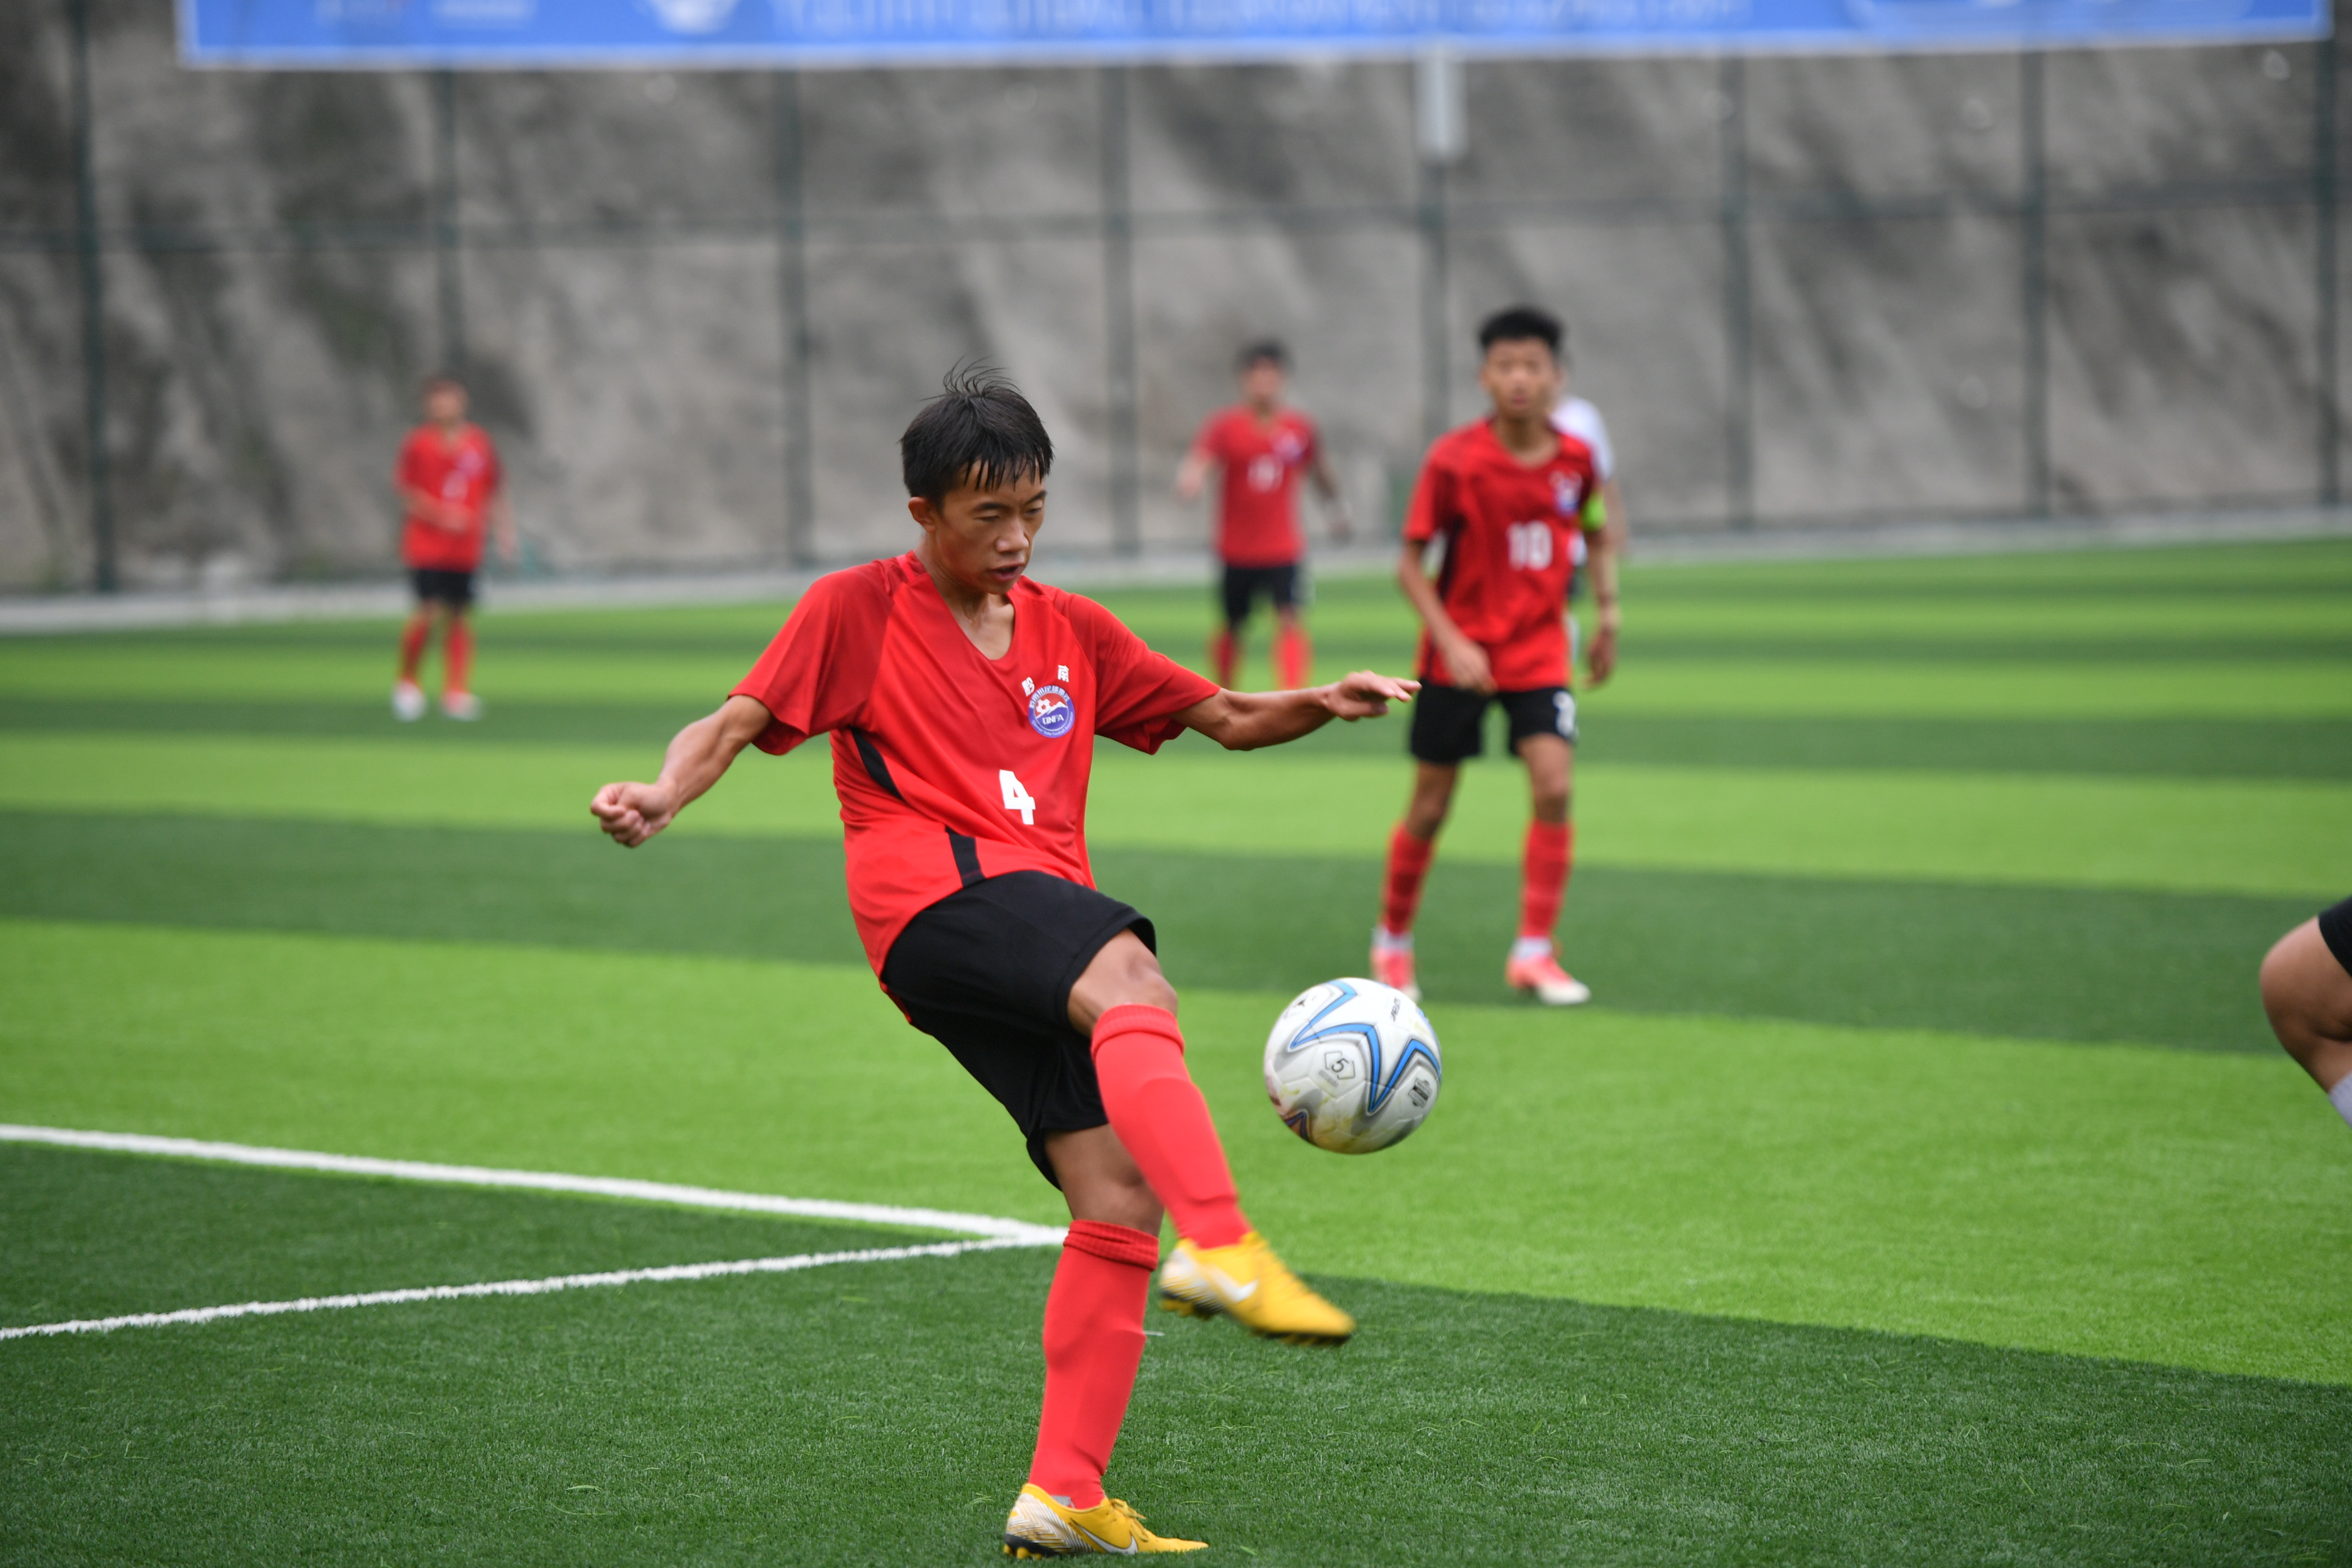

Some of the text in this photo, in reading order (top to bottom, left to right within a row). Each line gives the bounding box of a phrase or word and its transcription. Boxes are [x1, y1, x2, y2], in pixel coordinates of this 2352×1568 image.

[1507, 520, 1553, 569] 10
[1042, 714, 1064, 725] QNFA
[999, 769, 1036, 825] 4
[1331, 1058, 1349, 1073] 5
